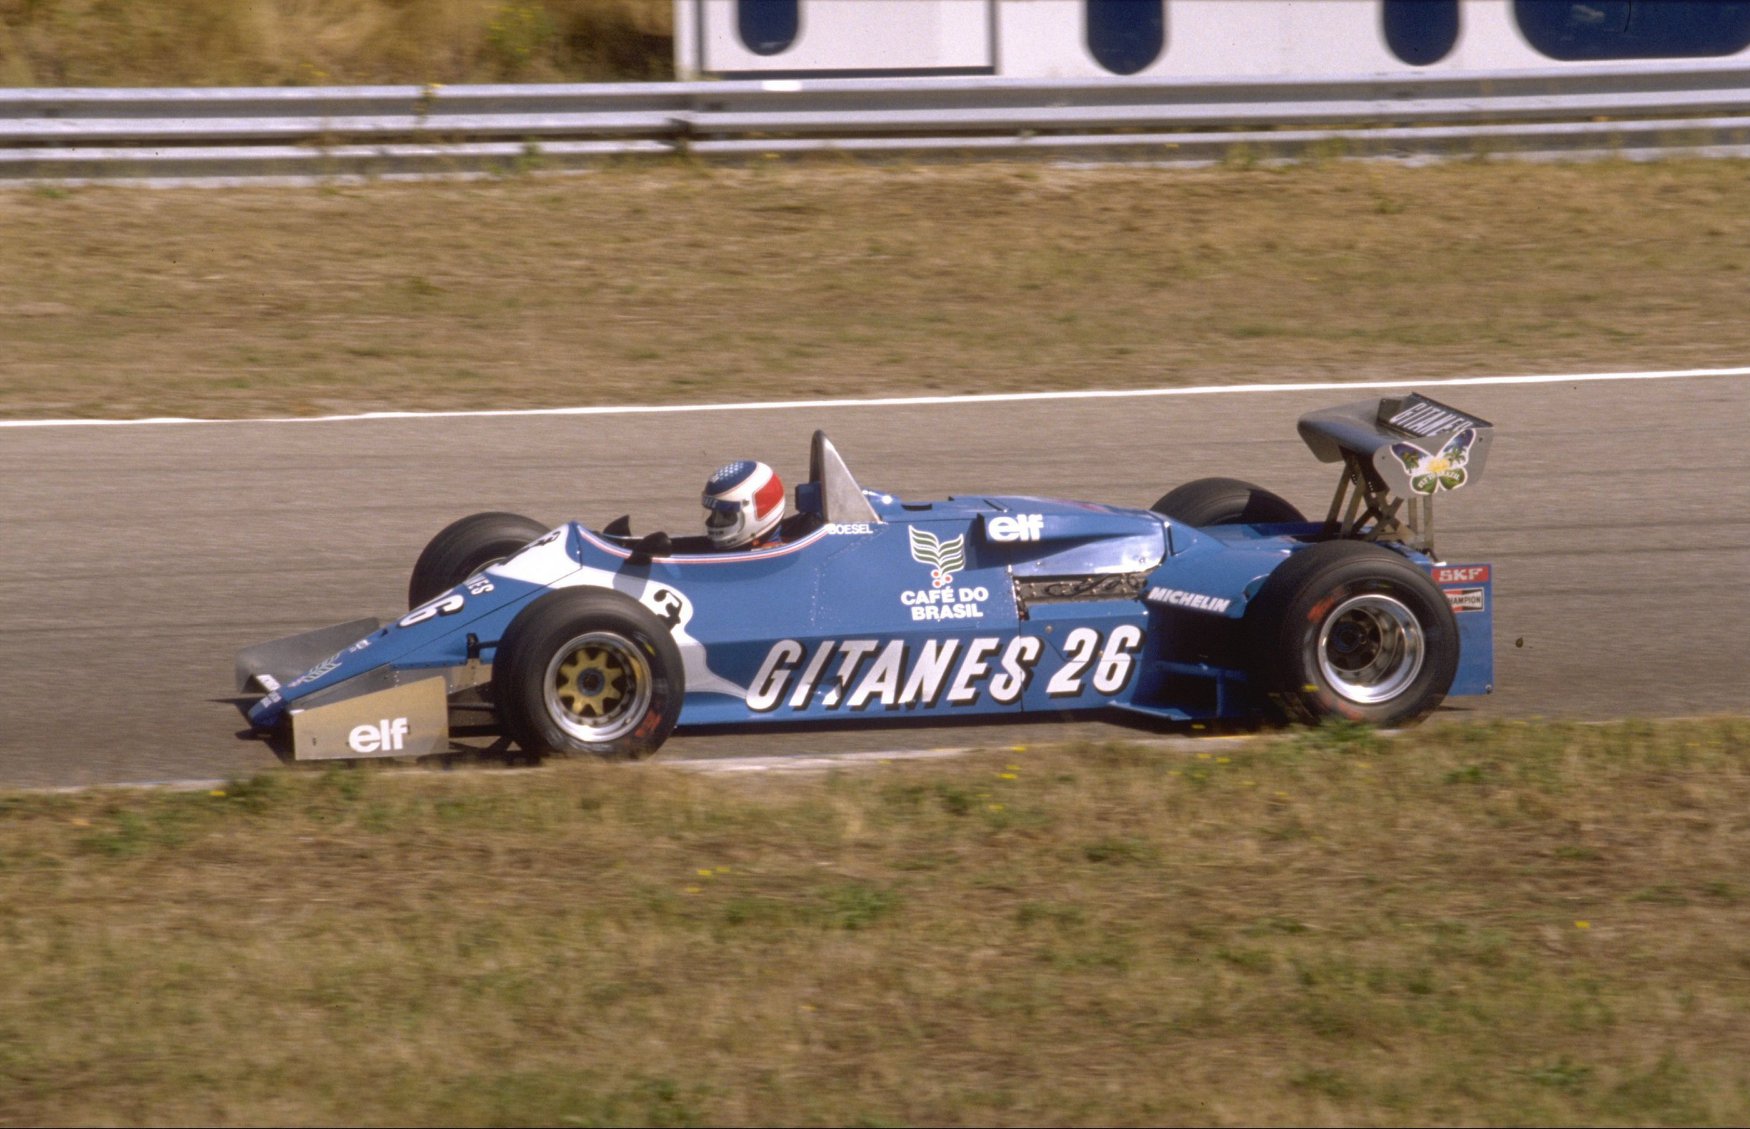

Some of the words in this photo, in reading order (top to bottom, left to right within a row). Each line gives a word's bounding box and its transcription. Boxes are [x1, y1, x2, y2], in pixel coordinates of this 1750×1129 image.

[828, 523, 874, 535] BOESEL
[988, 514, 1044, 541] elf
[1439, 567, 1483, 582] SKF
[900, 586, 955, 605] CAFÉ
[959, 586, 989, 602] DO
[1147, 586, 1231, 613] MICHELIN
[911, 603, 984, 621] BRASIL
[746, 636, 1042, 712] GITANES
[1046, 625, 1143, 695] 26
[348, 717, 408, 753] elf
